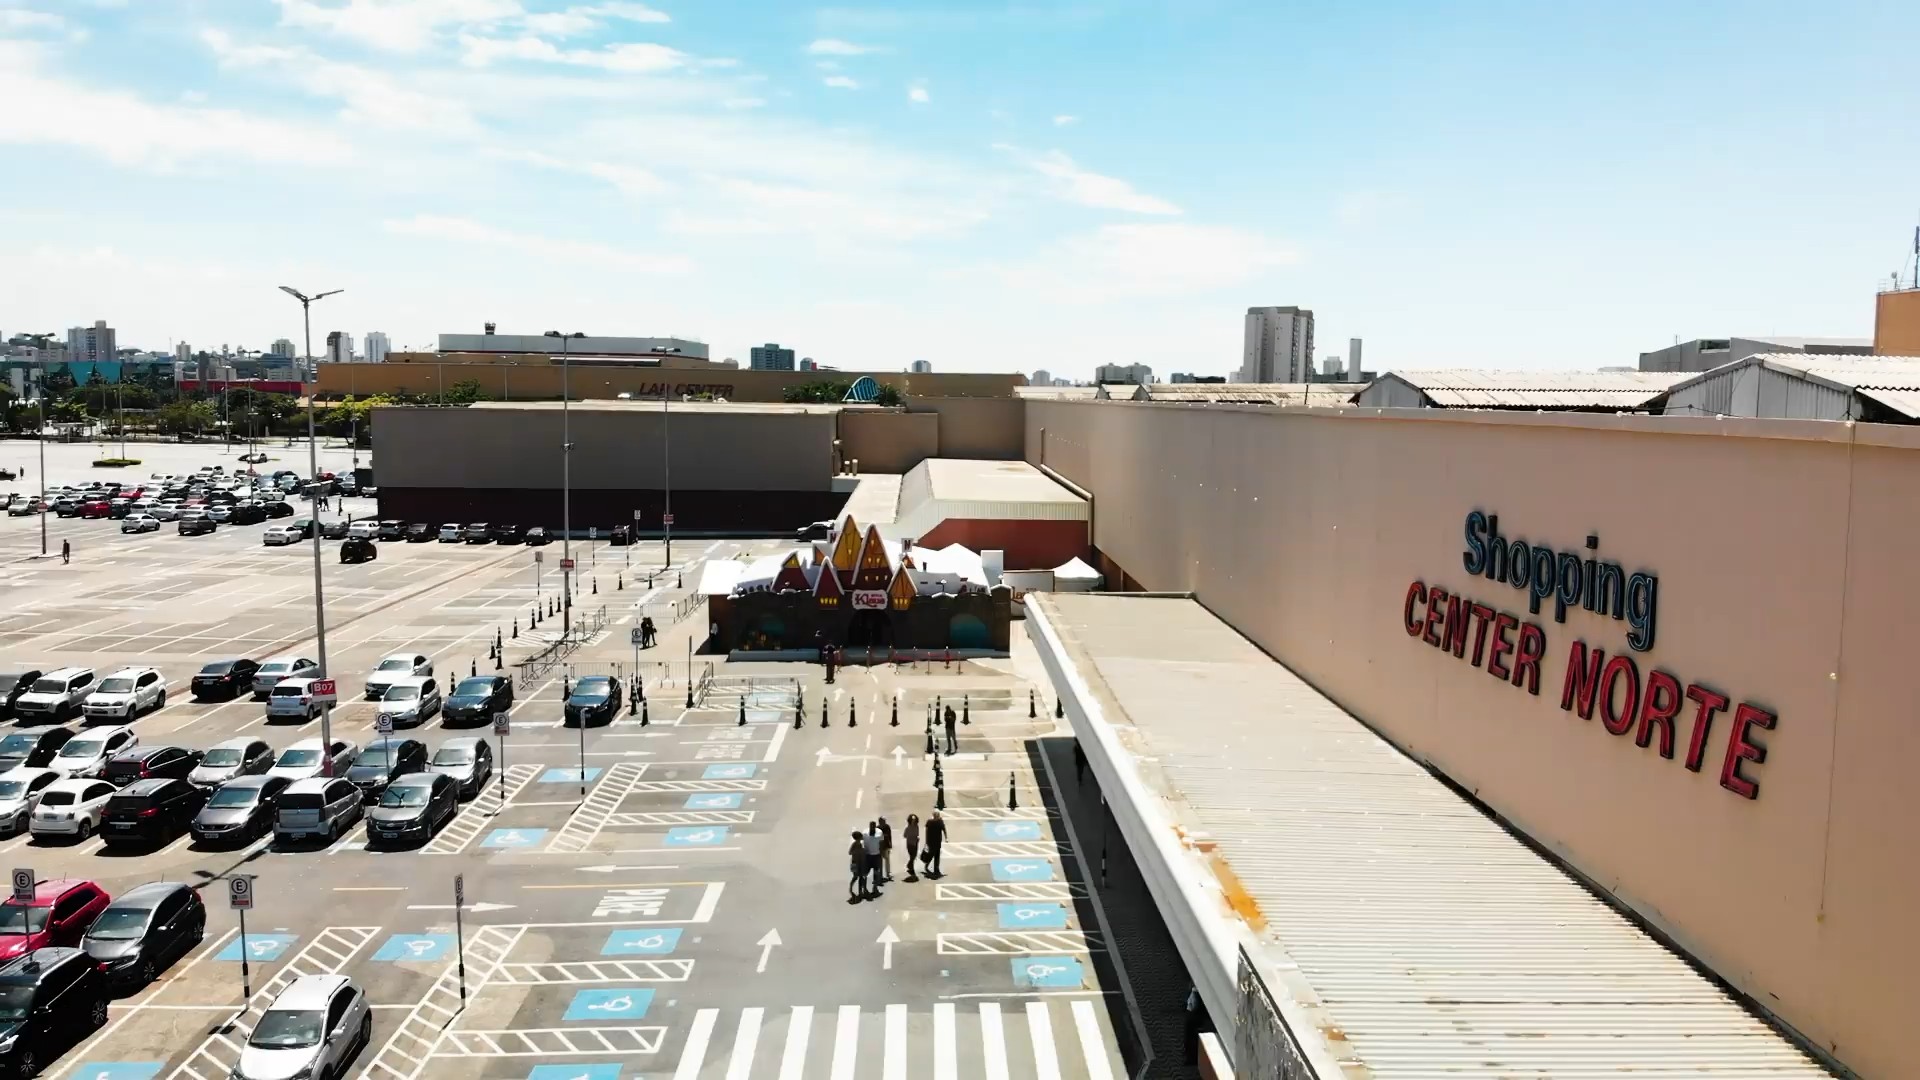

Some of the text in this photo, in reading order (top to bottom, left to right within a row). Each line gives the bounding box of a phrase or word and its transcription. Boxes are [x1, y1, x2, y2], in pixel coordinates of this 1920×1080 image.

[904, 539, 911, 551] N
[1463, 511, 1658, 652] Shopping
[313, 682, 333, 692] B07
[1404, 581, 1778, 800] CENTER NORTE
